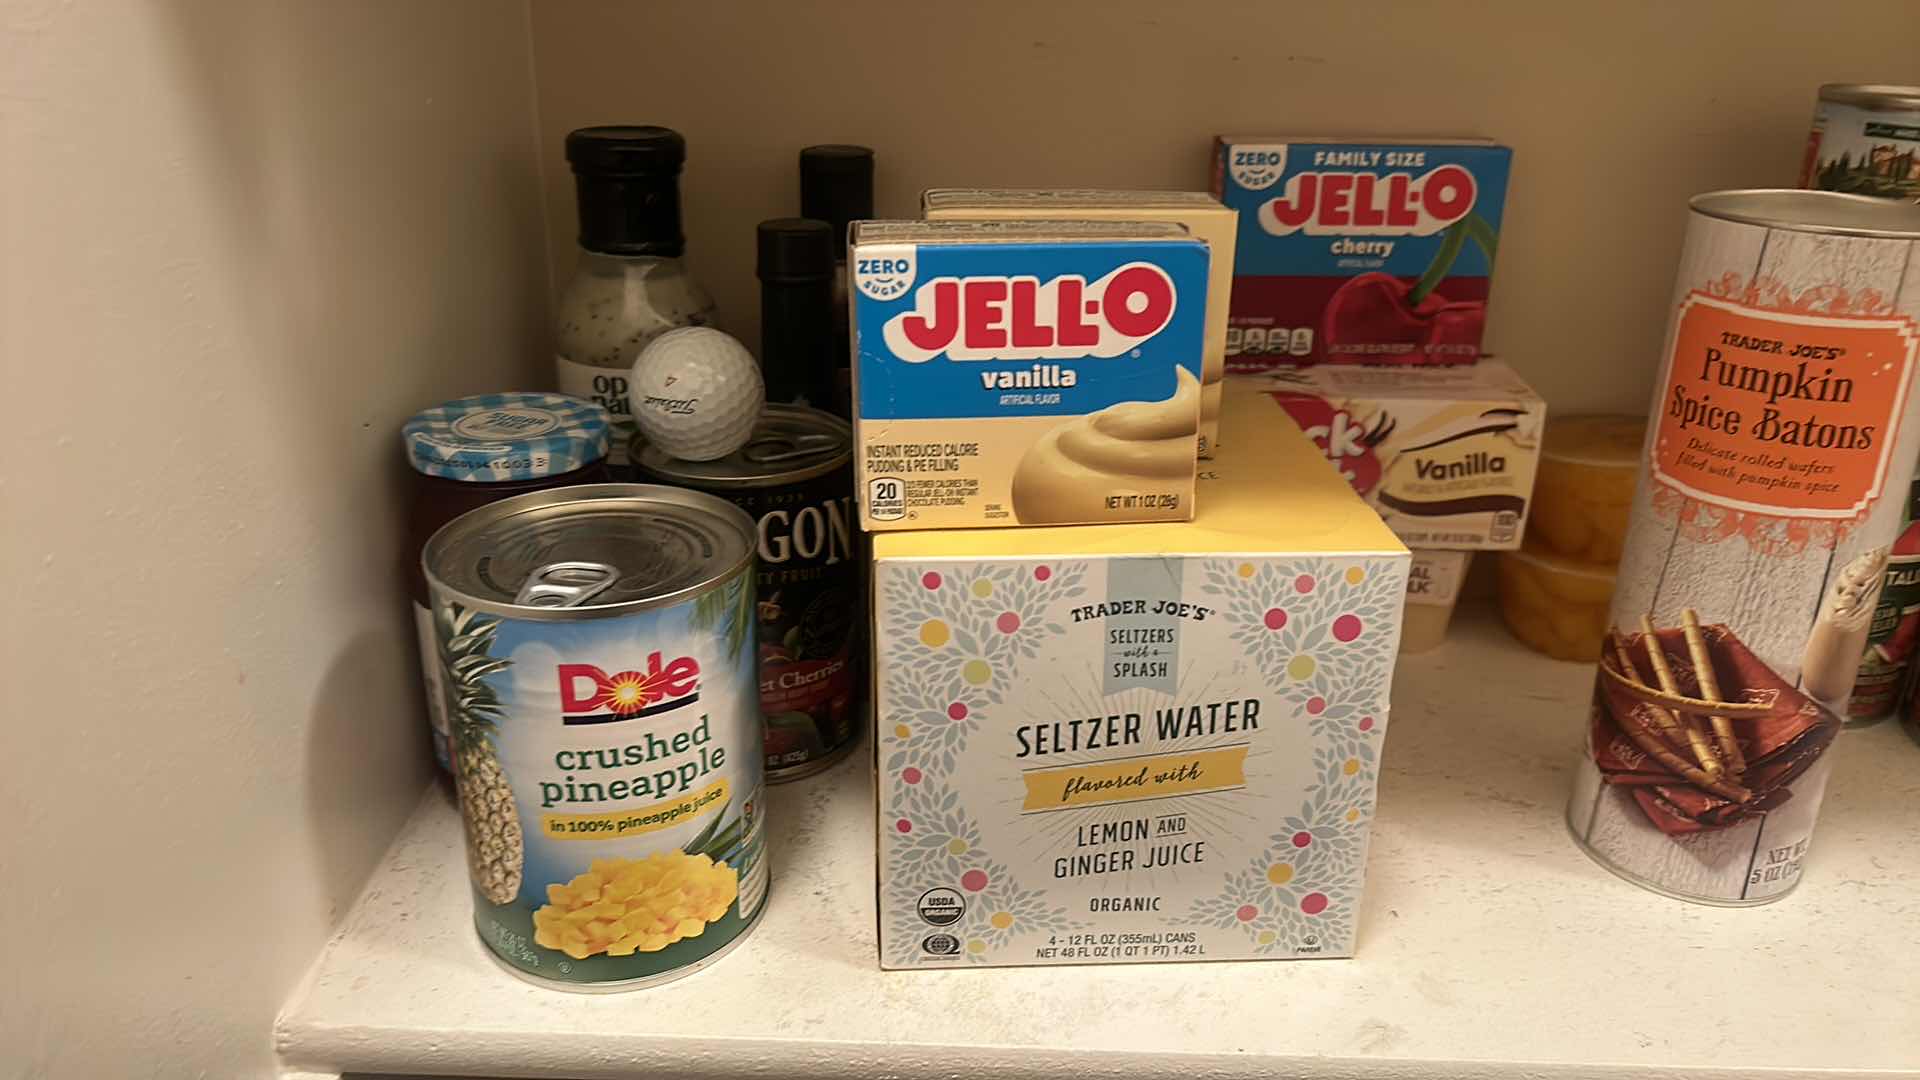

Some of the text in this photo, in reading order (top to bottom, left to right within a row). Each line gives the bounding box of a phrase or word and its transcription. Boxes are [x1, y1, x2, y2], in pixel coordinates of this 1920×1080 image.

[1234, 152, 1281, 166] ZERO
[1314, 152, 1425, 166] FAMILY SIZE
[1273, 168, 1474, 227] JELL-O
[1330, 239, 1394, 258] cherry
[858, 259, 909, 274] ZERO
[863, 280, 906, 296] SUGAR
[902, 266, 1173, 351] JELL-O
[1720, 332, 1783, 354] TRADER
[665, 376, 678, 387] 4
[981, 364, 1077, 390] vanilla
[1699, 348, 1853, 404] Pumpkin
[1669, 385, 1876, 450] Spice Batons
[866, 442, 979, 458] INSTANT REDUCED CALORIE
[1686, 437, 1835, 477] Delicate rolled wafers
[867, 459, 905, 472] PUDDING
[914, 458, 927, 471] PIE
[928, 458, 959, 471] FILLING
[1416, 452, 1506, 481] Vanilla
[1674, 451, 1841, 495] filled with pumpkin spice
[876, 483, 897, 499] 20
[1105, 496, 1121, 508] NET
[1123, 496, 1137, 508] WT
[1144, 495, 1156, 507] OZ
[1071, 600, 1210, 622] TRADER JOE'S
[1110, 628, 1175, 644] SELTZERS
[1123, 646, 1149, 658] with
[1113, 662, 1168, 678] SPLASH
[558, 651, 701, 714] Dole
[1016, 698, 1260, 758] SELTZER WATER
[555, 714, 712, 770] crushed
[539, 747, 726, 808] pineapple
[1063, 761, 1203, 801] flavored with
[551, 787, 724, 833] in 100% pineapple juice
[1078, 816, 1187, 847] LEMON AND
[1055, 841, 1205, 878] GINGER JUICE
[1750, 868, 1761, 884] 5
[928, 897, 956, 906] USDA
[1090, 897, 1161, 912] ORGANIC
[1049, 935, 1056, 946] 4
[1069, 935, 1081, 946] 12
[1084, 934, 1097, 945] FL
[1100, 934, 1116, 945] OZ
[1118, 933, 1162, 945] (355mL)
[1165, 932, 1196, 944] CANS
[1036, 944, 1206, 958] NET 48 FL OZ (1 QT 1 PT) 1.42 L
